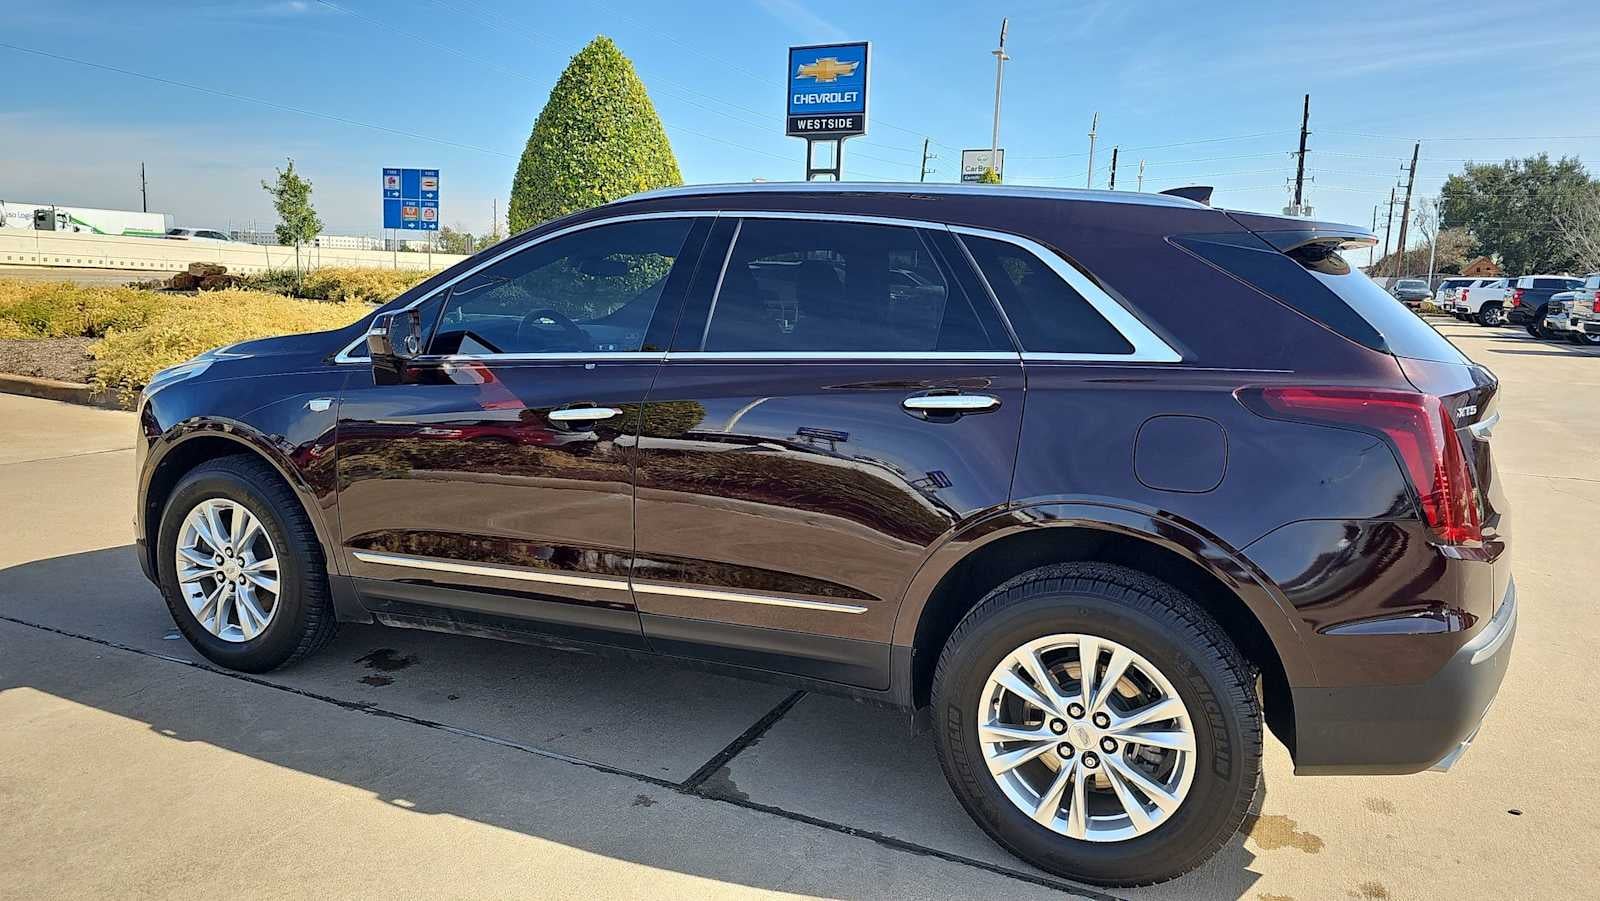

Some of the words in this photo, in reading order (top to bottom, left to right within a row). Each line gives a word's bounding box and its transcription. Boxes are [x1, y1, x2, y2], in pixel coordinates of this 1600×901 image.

[793, 91, 859, 105] CHEVROLET
[797, 118, 853, 130] WESTSIDE
[965, 164, 999, 172] CarBro
[1456, 405, 1477, 418] XT5
